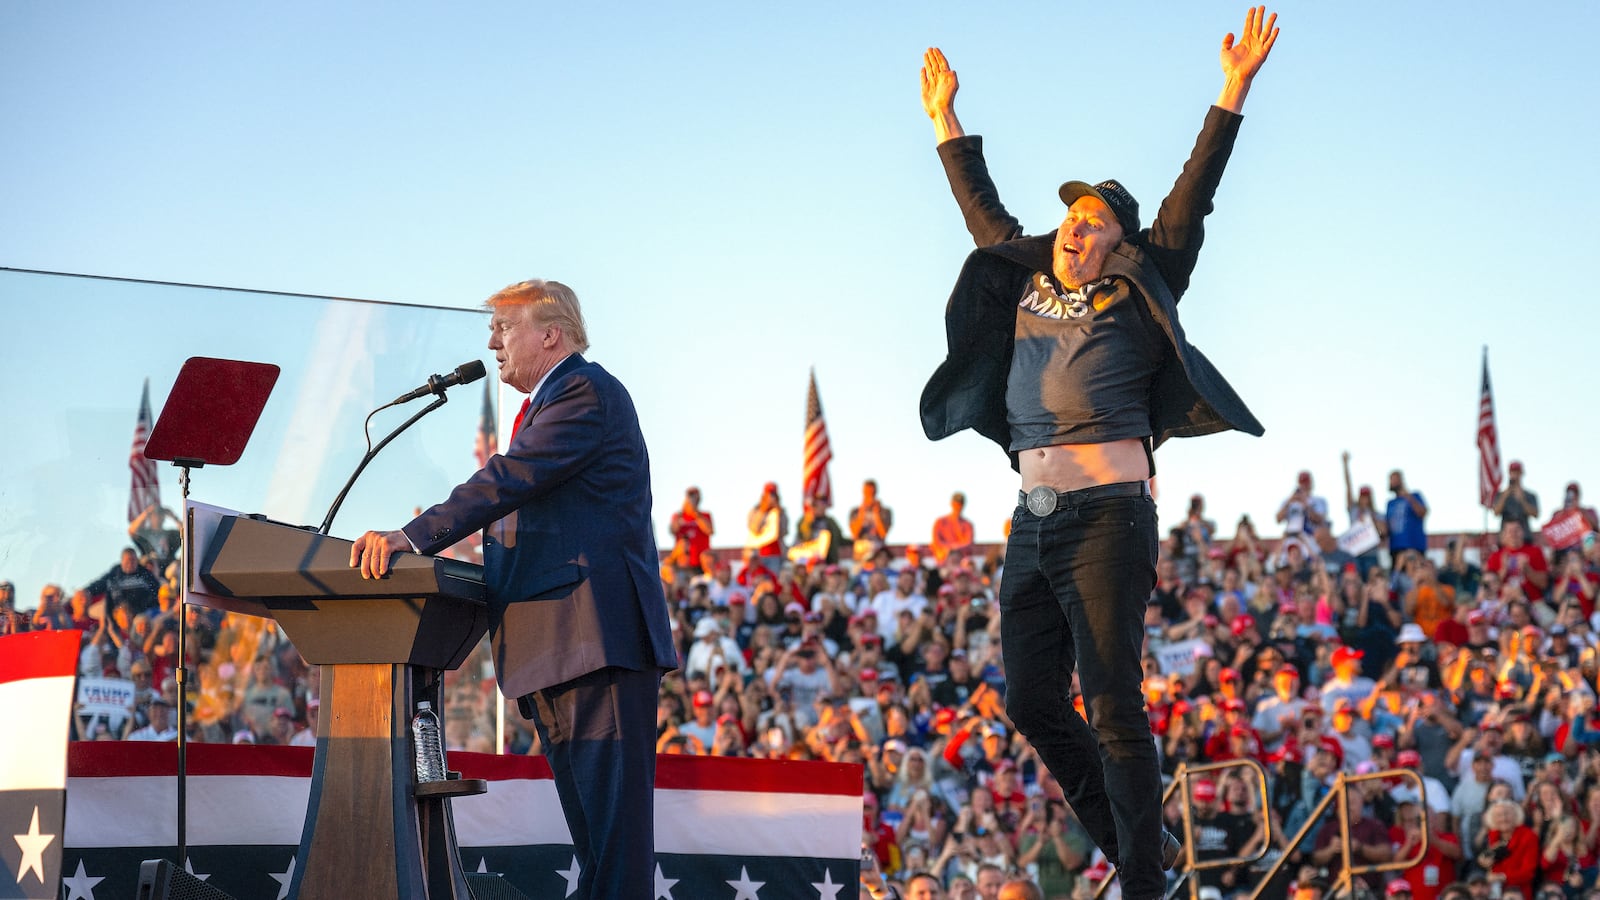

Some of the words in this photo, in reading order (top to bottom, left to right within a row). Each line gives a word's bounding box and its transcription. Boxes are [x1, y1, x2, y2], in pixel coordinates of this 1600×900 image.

[1099, 182, 1132, 205] AMERICA
[1100, 188, 1121, 206] AGAIN
[84, 686, 131, 699] TRUMP
